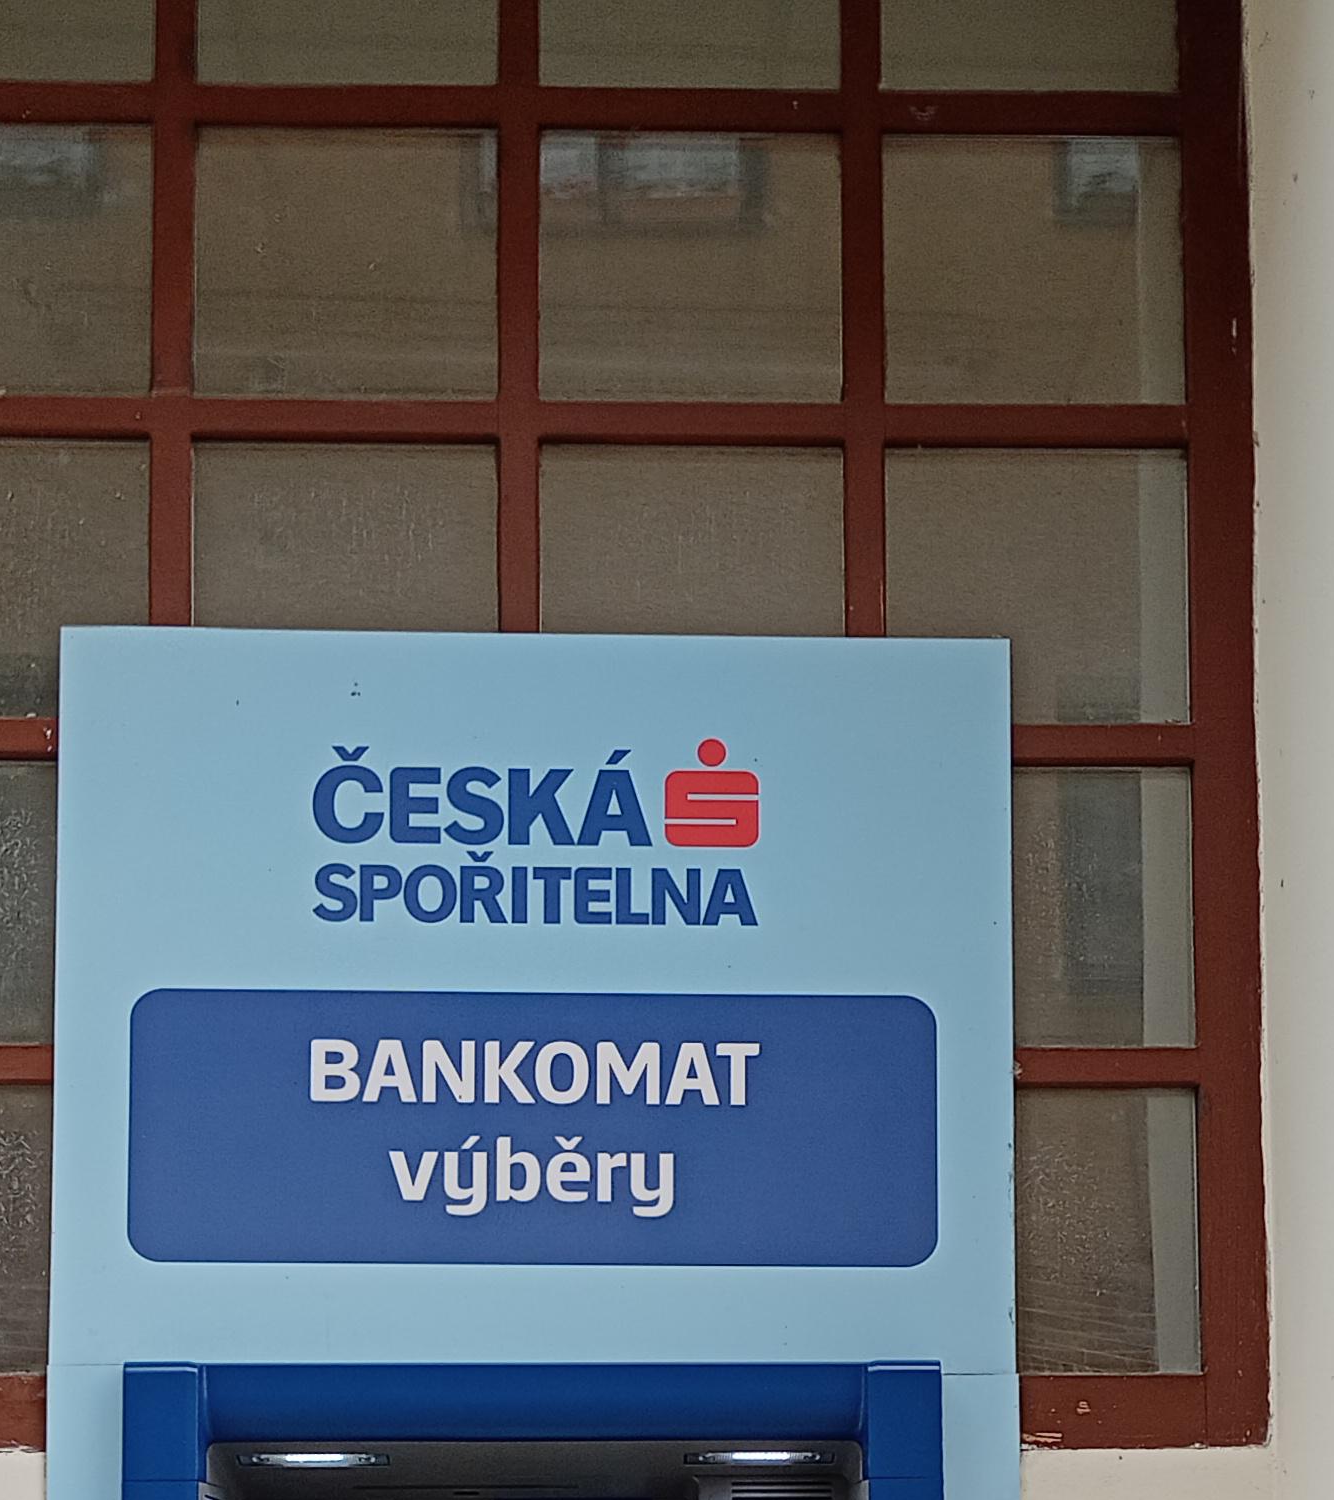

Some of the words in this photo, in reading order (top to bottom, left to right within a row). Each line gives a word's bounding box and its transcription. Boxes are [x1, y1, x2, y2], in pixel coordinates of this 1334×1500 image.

[312, 745, 653, 847] ČESKÁ
[312, 850, 759, 927] SPOŘITELNA
[310, 1038, 760, 1106] BANKOMAT
[388, 1135, 675, 1217] výběry
